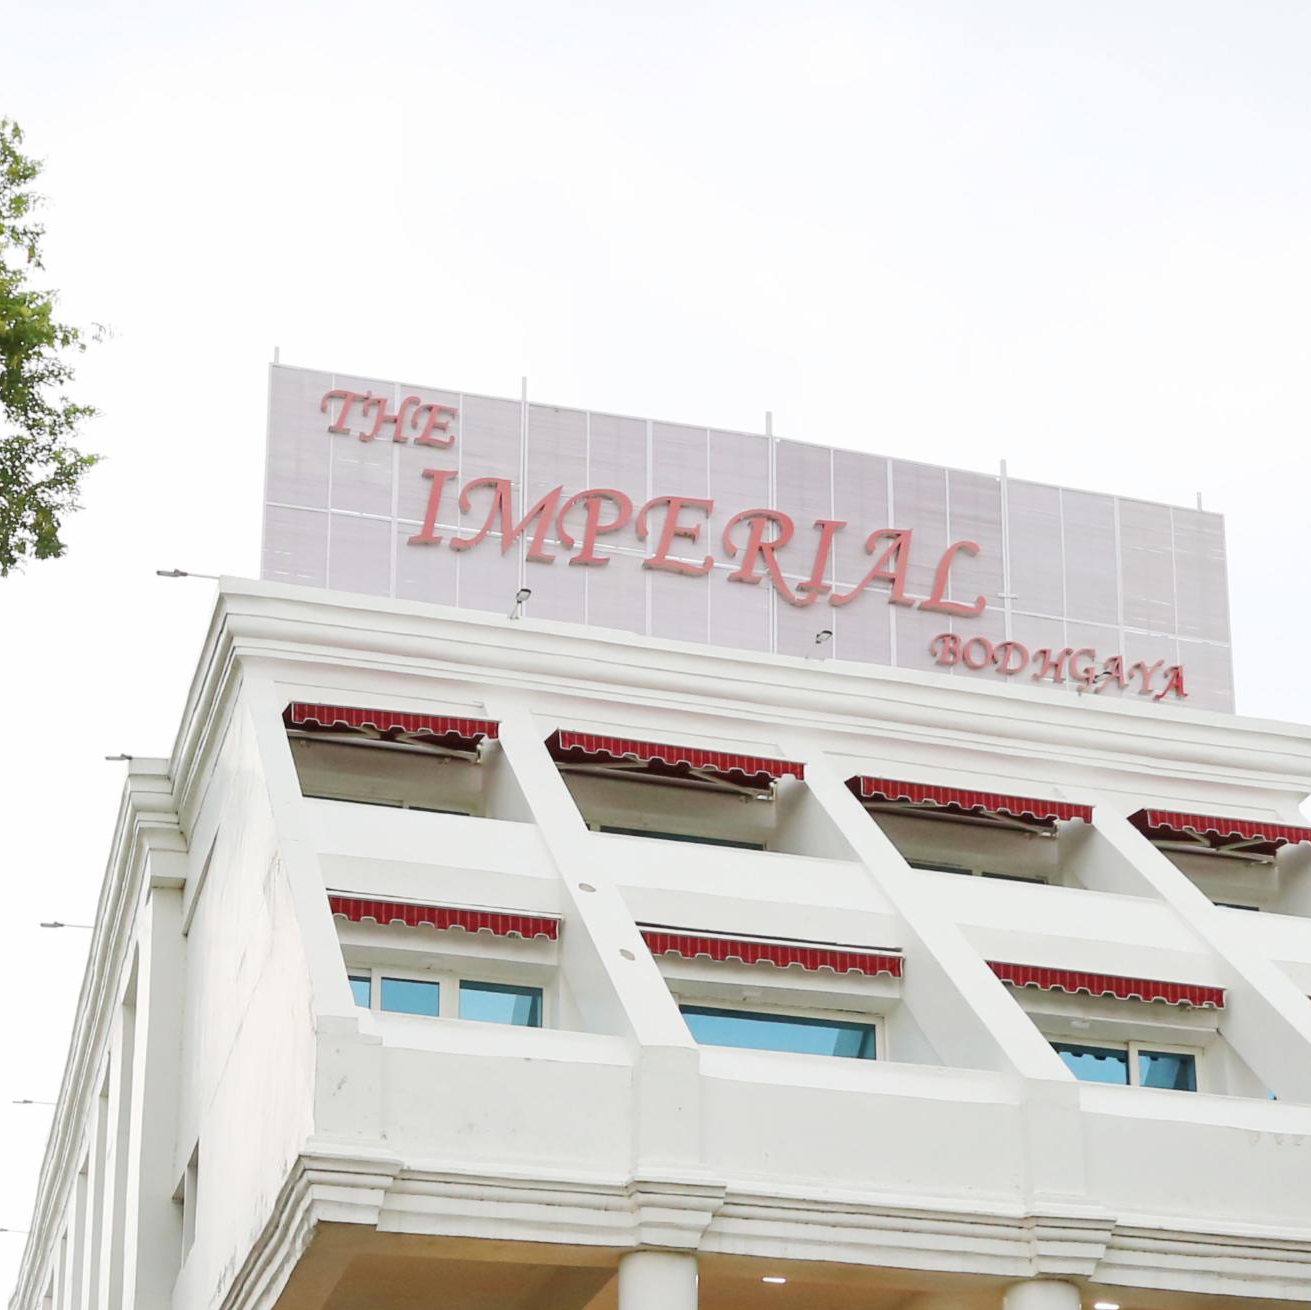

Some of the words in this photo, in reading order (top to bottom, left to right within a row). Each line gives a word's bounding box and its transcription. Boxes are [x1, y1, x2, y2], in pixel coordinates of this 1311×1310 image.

[321, 389, 458, 449] THE
[407, 468, 987, 618] IMPERIAL
[929, 632, 1188, 701] BODHGAYA
